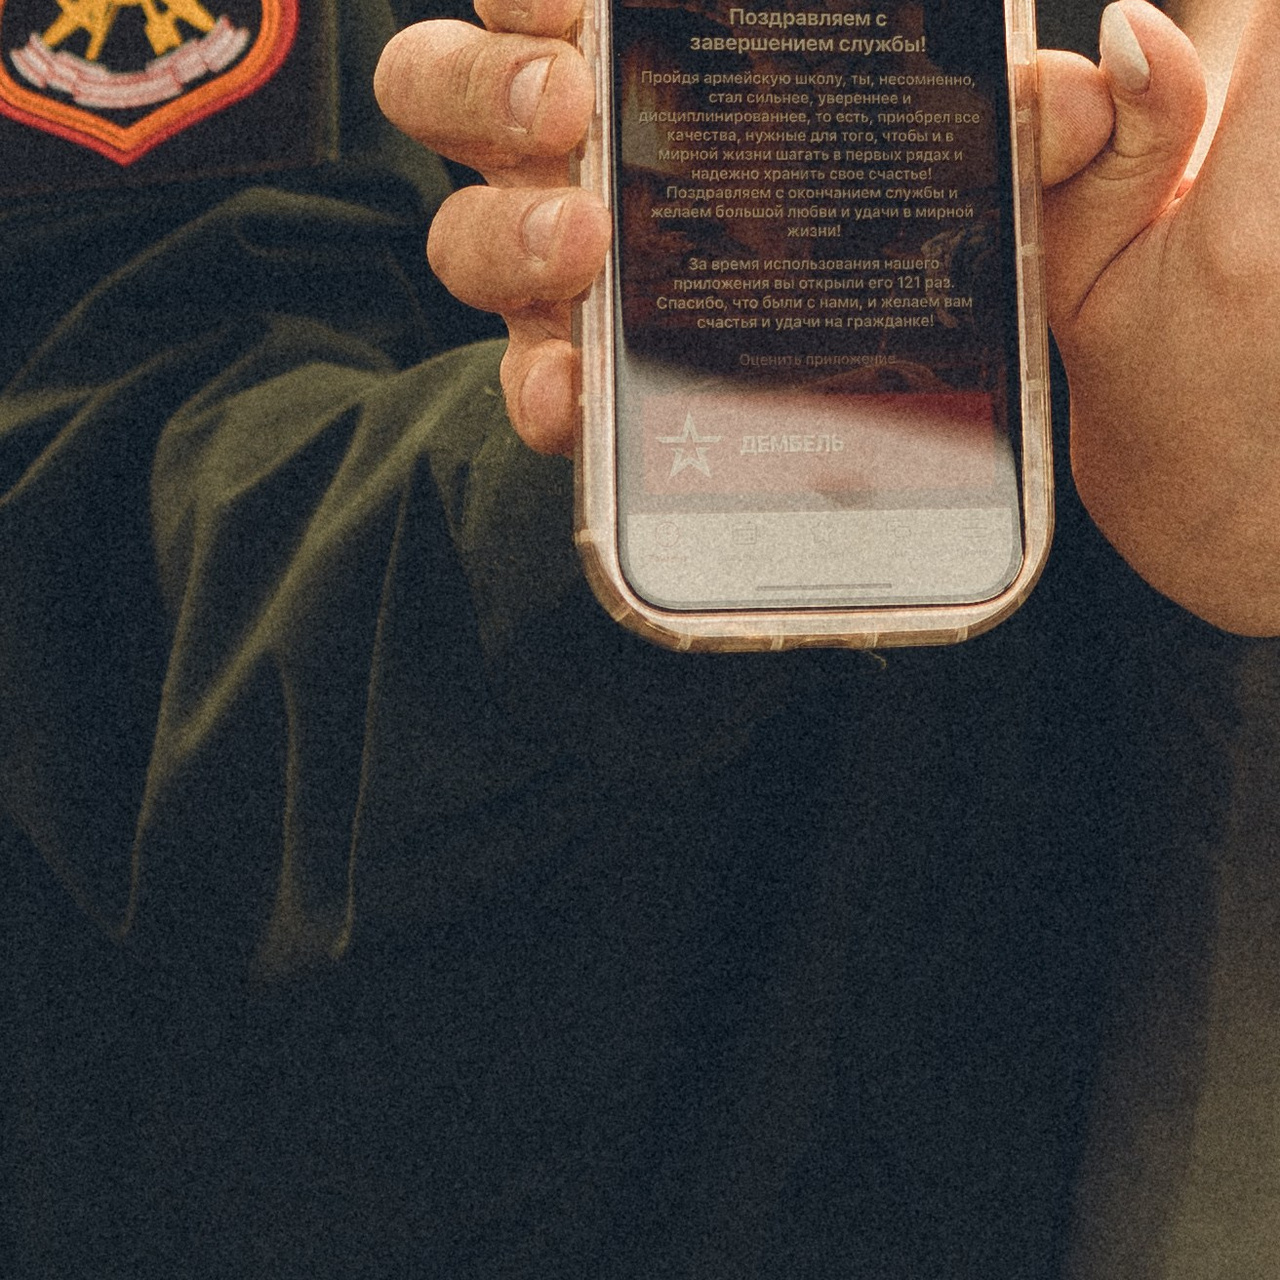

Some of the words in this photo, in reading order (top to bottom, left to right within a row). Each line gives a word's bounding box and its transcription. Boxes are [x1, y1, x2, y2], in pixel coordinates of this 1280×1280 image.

[730, 9, 871, 29] Поздравляем
[876, 14, 887, 26] с
[690, 36, 834, 54] завершением
[839, 36, 925, 54] службы!
[642, 71, 700, 86] Пройдя
[704, 72, 791, 87] армейскую
[795, 74, 846, 88] школу,
[851, 74, 874, 87] ты,
[879, 74, 975, 89] несомненно,
[709, 93, 742, 103] стал
[747, 93, 813, 106] сильнее,
[818, 93, 898, 106] увереннее
[902, 94, 911, 103] и
[639, 111, 810, 125] дисциплинированнее,
[816, 112, 831, 122] то
[836, 112, 873, 125] есть,
[878, 111, 951, 126] приобрел
[954, 113, 980, 123] все
[667, 131, 740, 144] качества,
[745, 131, 806, 144] нужные
[810, 131, 837, 144] для
[841, 131, 878, 144] того,
[883, 129, 928, 142] чтобы
[932, 132, 941, 142] и
[946, 132, 953, 142] в
[658, 148, 718, 163] мирной
[723, 150, 771, 161] жизни
[776, 150, 828, 161] шагать
[834, 150, 842, 161] в
[846, 150, 902, 164] первых
[906, 151, 949, 164] рядах
[954, 151, 962, 161] и
[691, 169, 759, 182] надежно
[764, 169, 825, 180] хранить
[830, 169, 864, 180] свое
[869, 168, 932, 180] счастье!
[667, 186, 771, 201] Поздравляем
[776, 188, 784, 198] с
[788, 188, 881, 198] окончанием
[886, 186, 944, 201] службы
[949, 188, 958, 198] и
[651, 207, 711, 218] желаем
[716, 204, 783, 218] большой
[788, 204, 837, 218] любви
[841, 207, 850, 218] и
[854, 207, 899, 220] удачи
[903, 207, 911, 218] в
[916, 204, 973, 221] мирной
[787, 225, 841, 237] жизни!
[688, 258, 708, 270] За
[712, 260, 759, 273] время
[763, 260, 880, 273] использования
[884, 259, 939, 270] нашего
[674, 279, 769, 292] приложения
[774, 279, 795, 289] вы
[800, 279, 863, 292] открыли
[868, 279, 892, 289] его
[897, 276, 920, 288] 121
[925, 278, 954, 291] раз.
[657, 296, 728, 311] Спасибо,
[732, 298, 758, 308] что
[762, 296, 802, 308] были
[807, 298, 815, 308] с
[819, 298, 862, 311] нами,
[868, 298, 876, 308] и
[881, 298, 940, 308] желаем
[944, 297, 972, 308] вам
[697, 318, 757, 328] счастья
[762, 318, 770, 328] и
[775, 318, 820, 331] удачи
[825, 318, 843, 328] на
[847, 316, 935, 331] гражданке!
[740, 434, 845, 456] ДЕМБЕЛЬ
